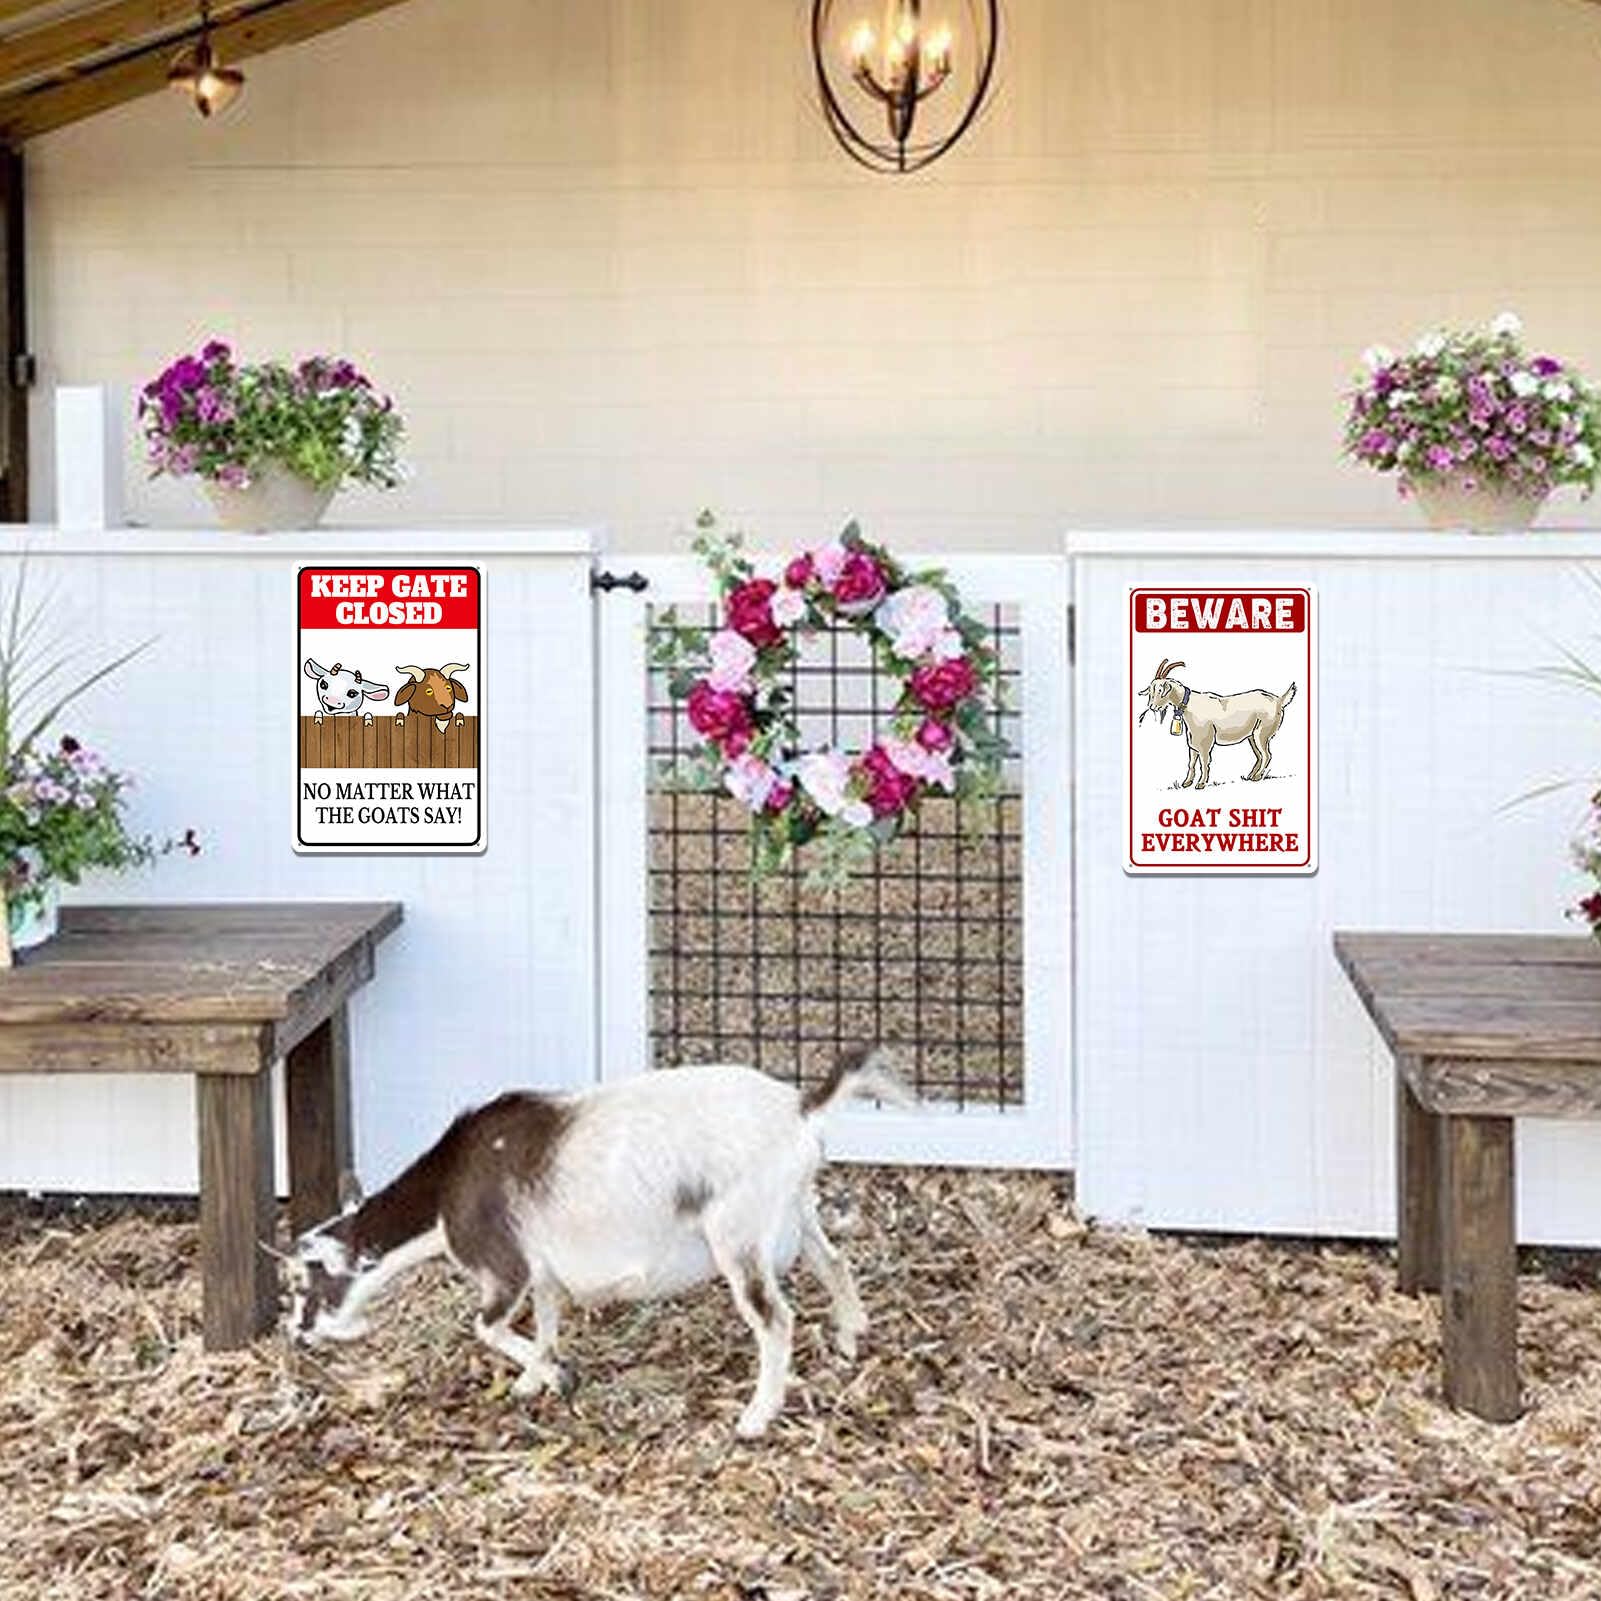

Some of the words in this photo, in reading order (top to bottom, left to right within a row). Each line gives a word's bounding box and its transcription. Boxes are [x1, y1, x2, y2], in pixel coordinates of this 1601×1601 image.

[311, 575, 384, 598] KEEP
[391, 575, 467, 598] GATE
[335, 601, 443, 625] CLOSED
[1145, 598, 1295, 630] BEWARE
[303, 783, 331, 800] NO
[335, 783, 414, 800] MATTER
[417, 783, 475, 800] WHAT
[315, 807, 354, 824] THE
[358, 807, 420, 824] GOATS
[424, 807, 462, 824] SAY!
[1158, 808, 1221, 828] GOAT
[1228, 808, 1283, 828] SHIT
[1141, 833, 1299, 852] EVERYWHERE
